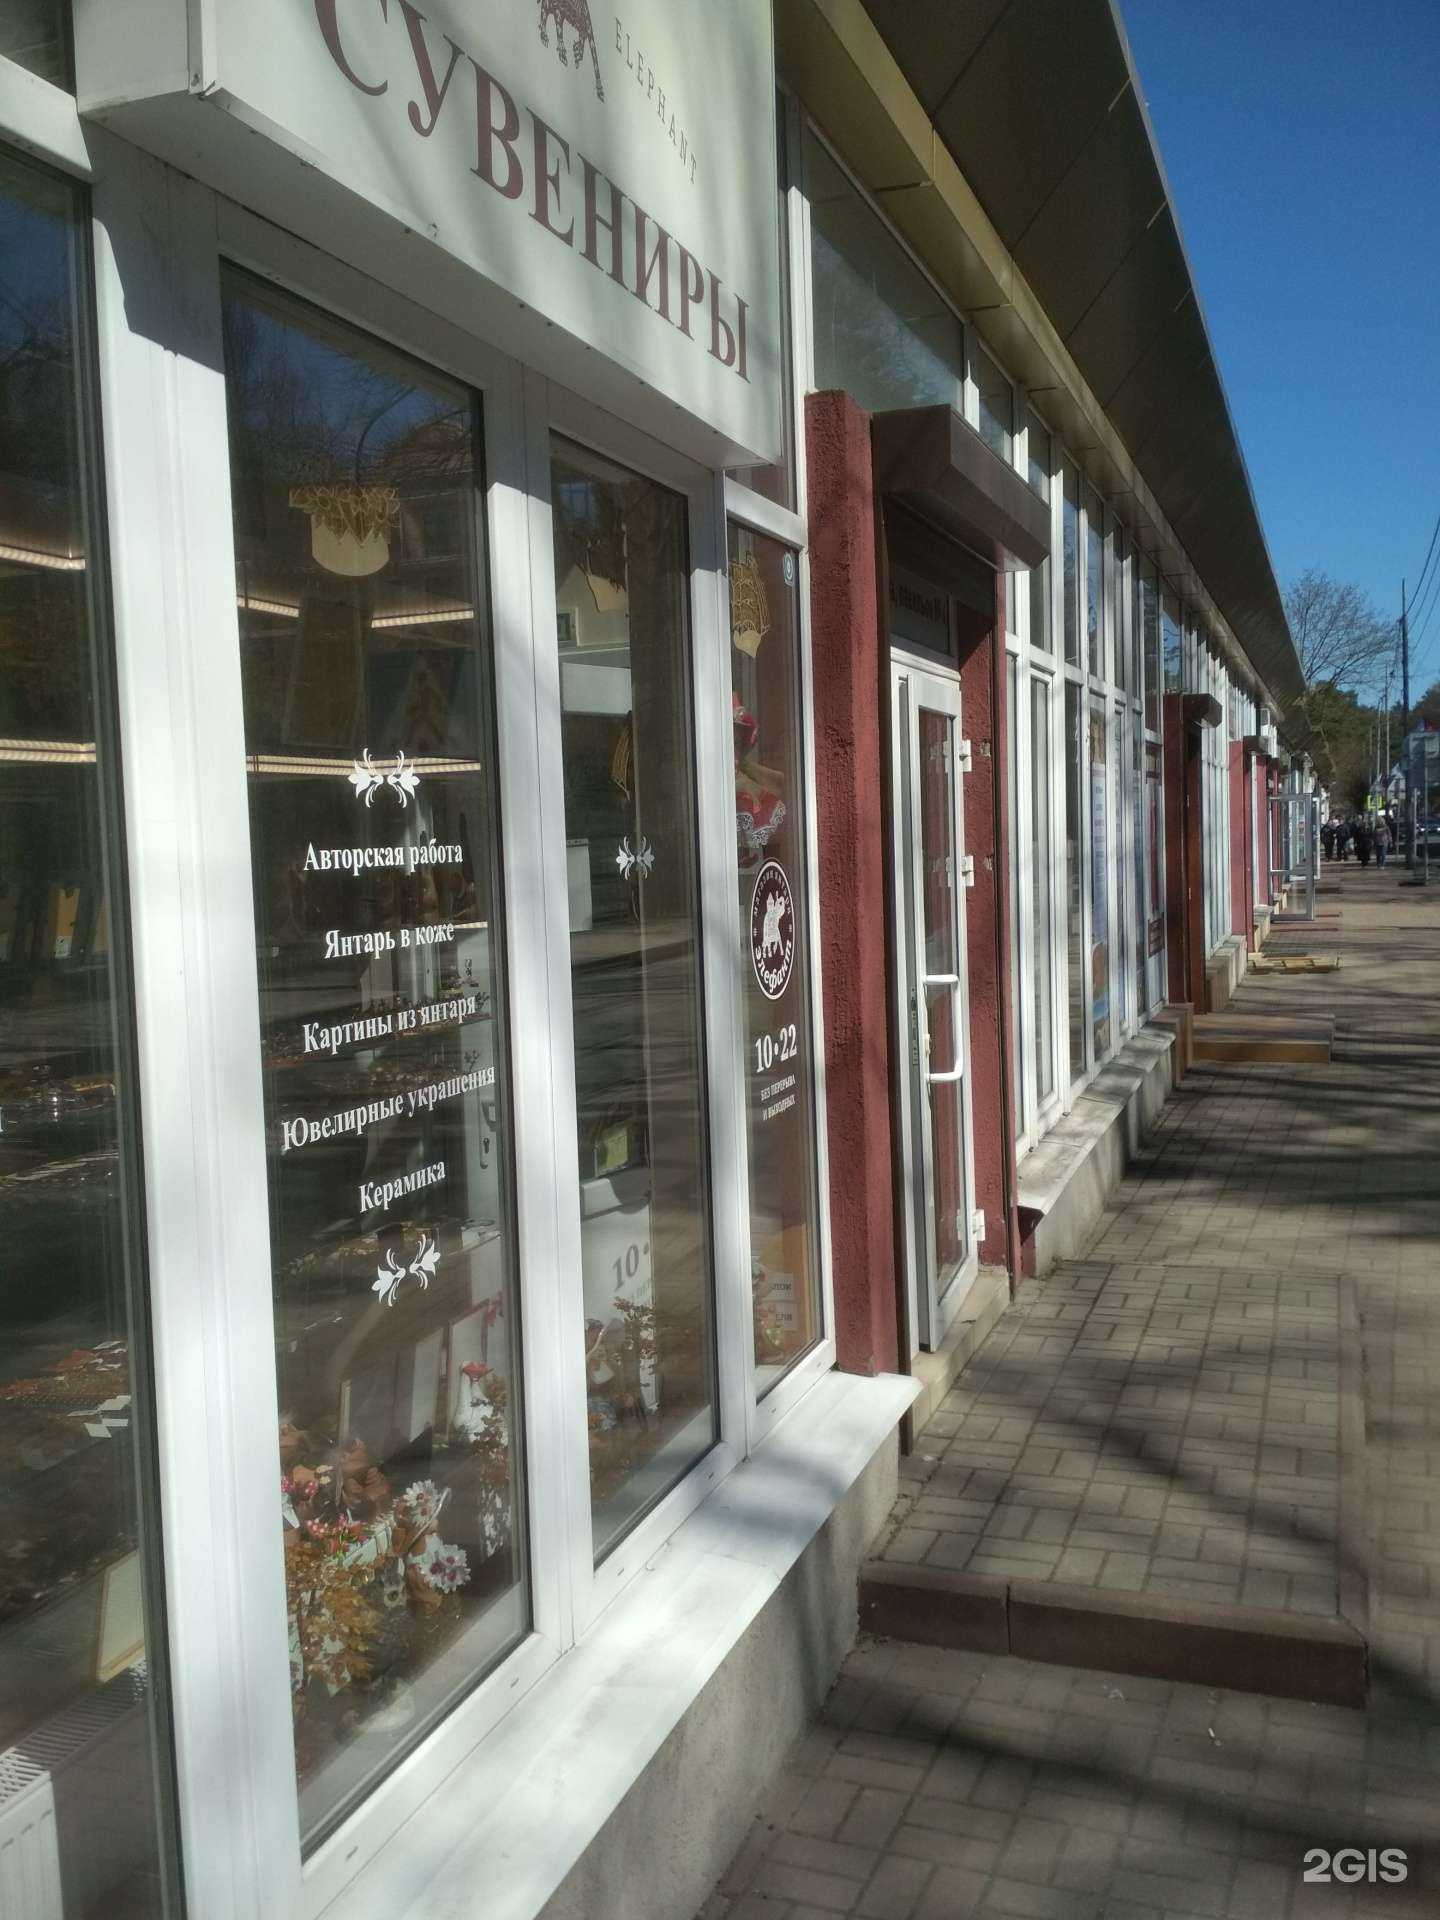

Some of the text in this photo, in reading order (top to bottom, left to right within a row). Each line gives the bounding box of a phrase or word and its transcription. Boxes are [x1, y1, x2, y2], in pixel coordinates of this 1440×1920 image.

[615, 17, 698, 185] ELEPHANT
[313, 0, 752, 384] СУВЕНИРЫ
[303, 838, 463, 876] Авторская работа
[324, 922, 455, 959] Янтарь в коже
[302, 996, 477, 1055] Картины из янтаря
[281, 1066, 495, 1152] Ювелирные украшения
[358, 1161, 446, 1213] Керамика
